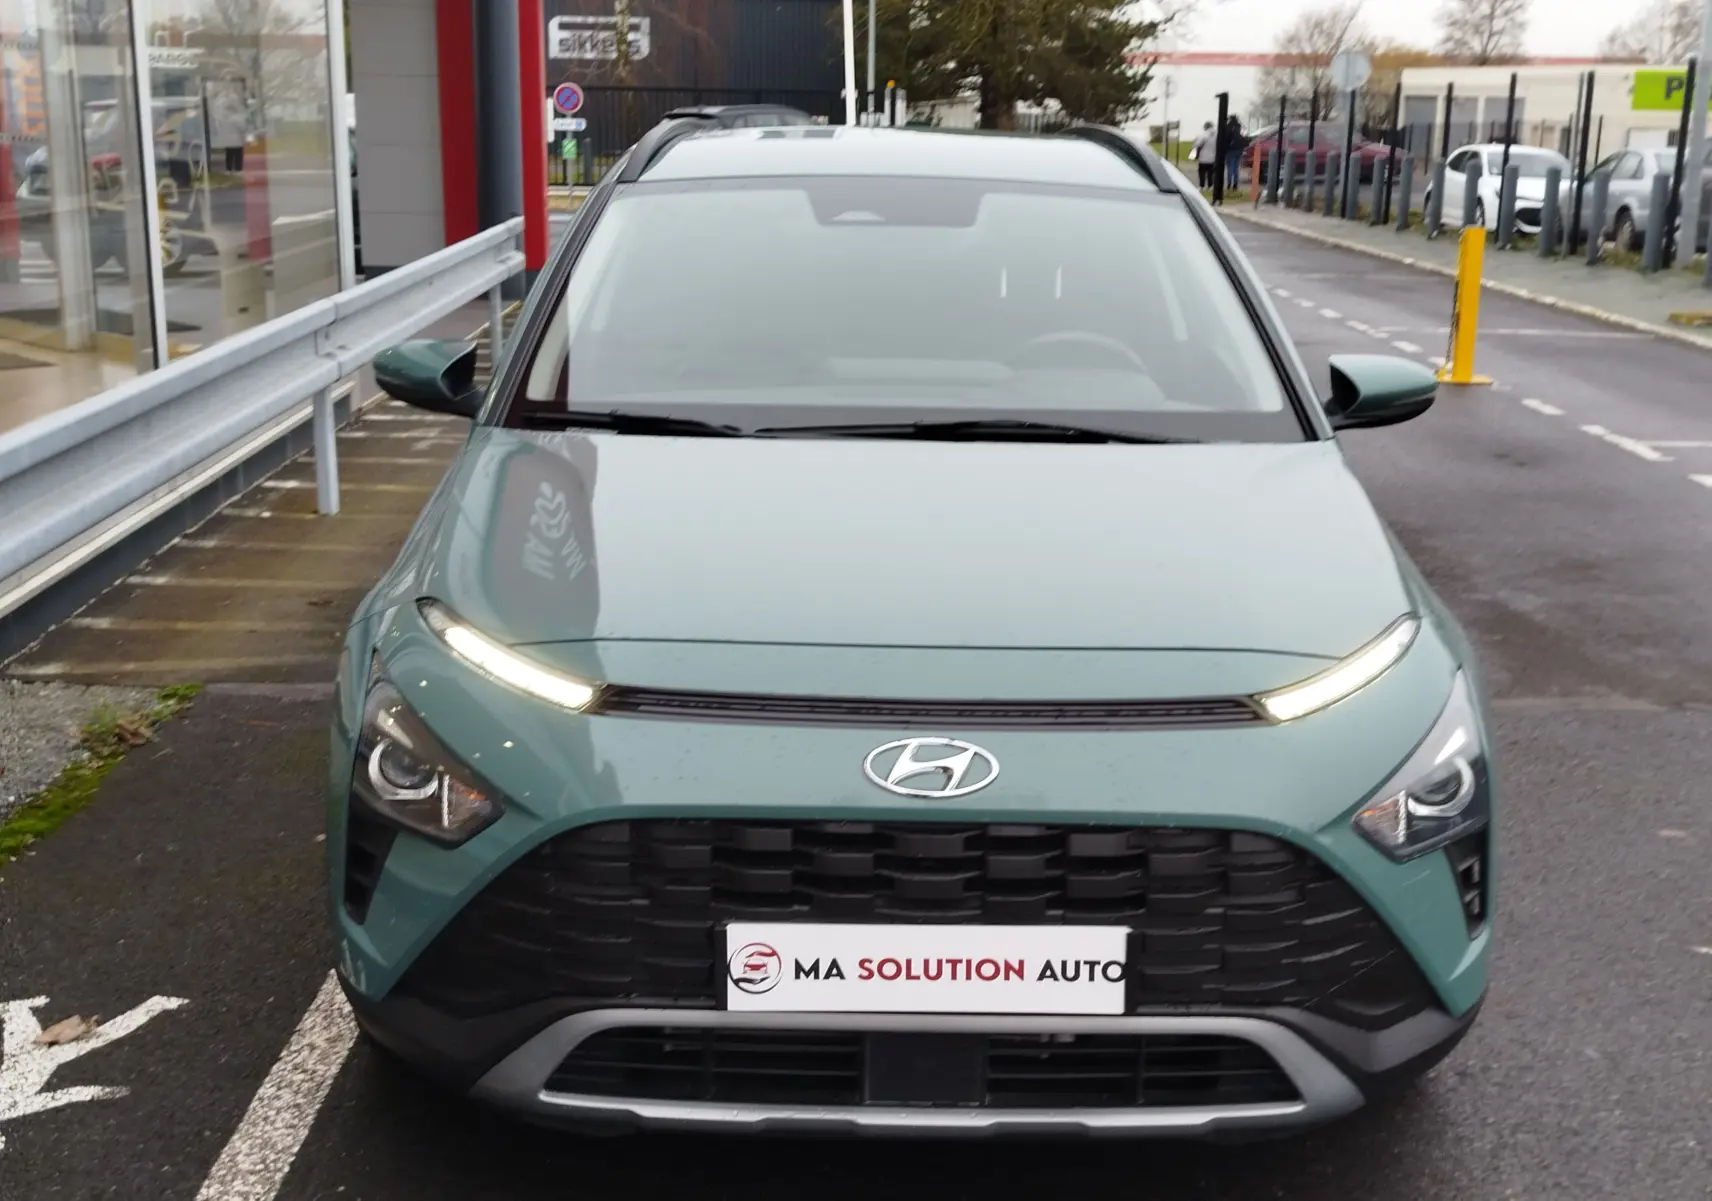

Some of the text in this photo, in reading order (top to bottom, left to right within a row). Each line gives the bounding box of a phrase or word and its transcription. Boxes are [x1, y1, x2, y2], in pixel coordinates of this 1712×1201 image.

[559, 31, 640, 55] sikkes
[794, 957, 1126, 983] MA SOLUTION AUTO
